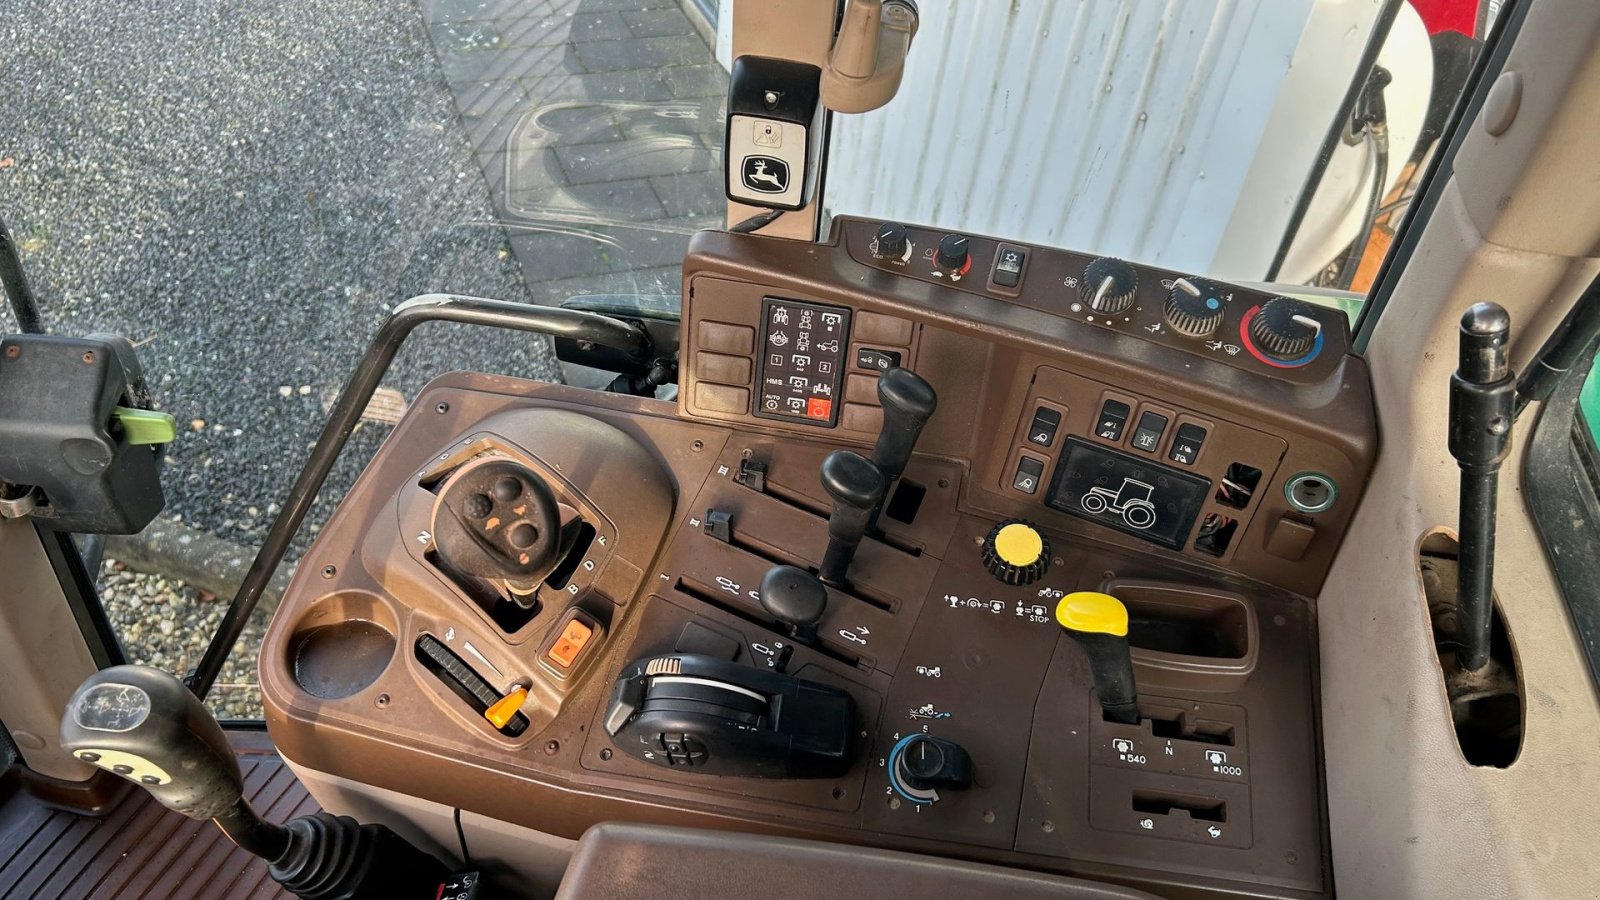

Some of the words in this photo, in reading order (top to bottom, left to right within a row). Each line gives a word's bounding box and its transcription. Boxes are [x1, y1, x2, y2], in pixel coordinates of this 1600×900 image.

[766, 377, 783, 386] HMS
[416, 530, 432, 544] N
[597, 535, 608, 547] F
[583, 559, 595, 572] D
[567, 583, 579, 596] B
[1029, 614, 1050, 623] STOP
[922, 724, 929, 733] 5
[893, 732, 900, 741] 4
[1165, 746, 1174, 756] N
[879, 758, 885, 767] 3
[1127, 753, 1147, 764] 540
[1219, 765, 1242, 776] 1000
[886, 786, 893, 795] 2
[915, 804, 921, 814] 1
